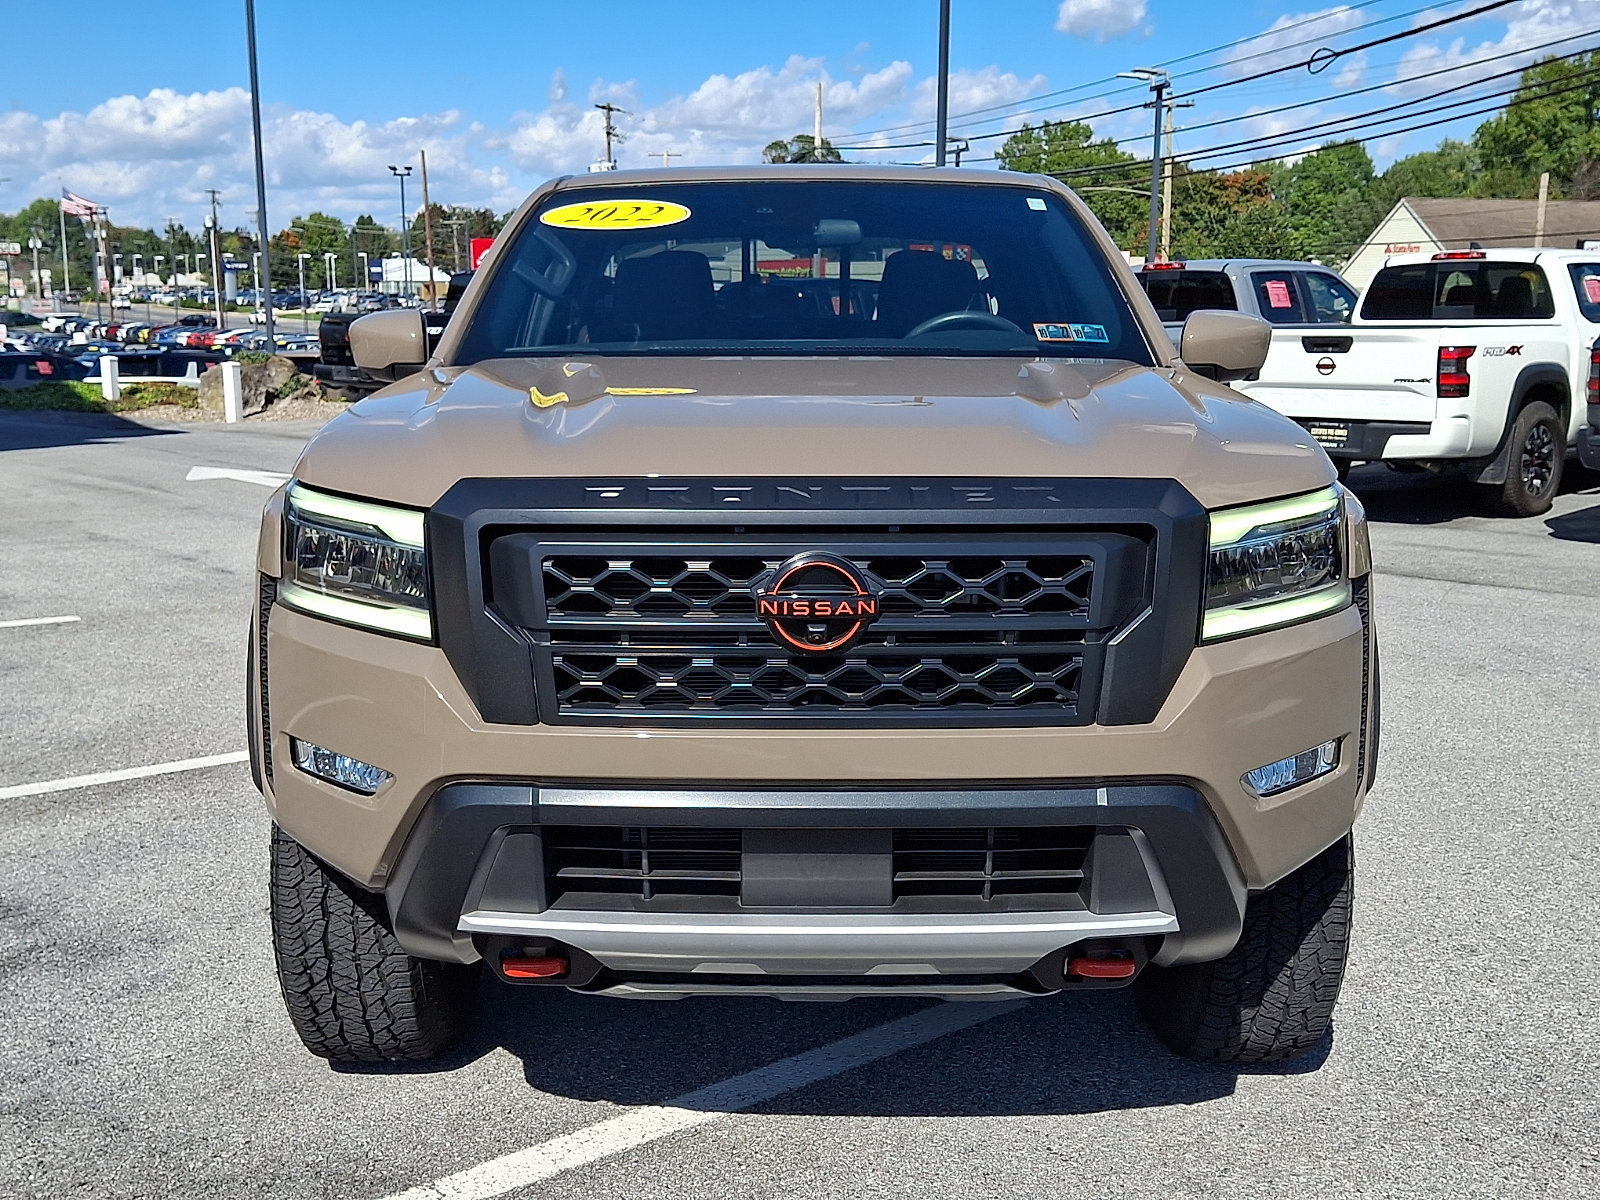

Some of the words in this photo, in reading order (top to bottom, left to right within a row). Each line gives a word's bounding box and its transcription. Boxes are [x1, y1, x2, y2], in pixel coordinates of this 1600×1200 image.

[563, 206, 665, 222] 2022
[583, 485, 1063, 506] FRONTIER
[760, 599, 875, 616] NISSAN
